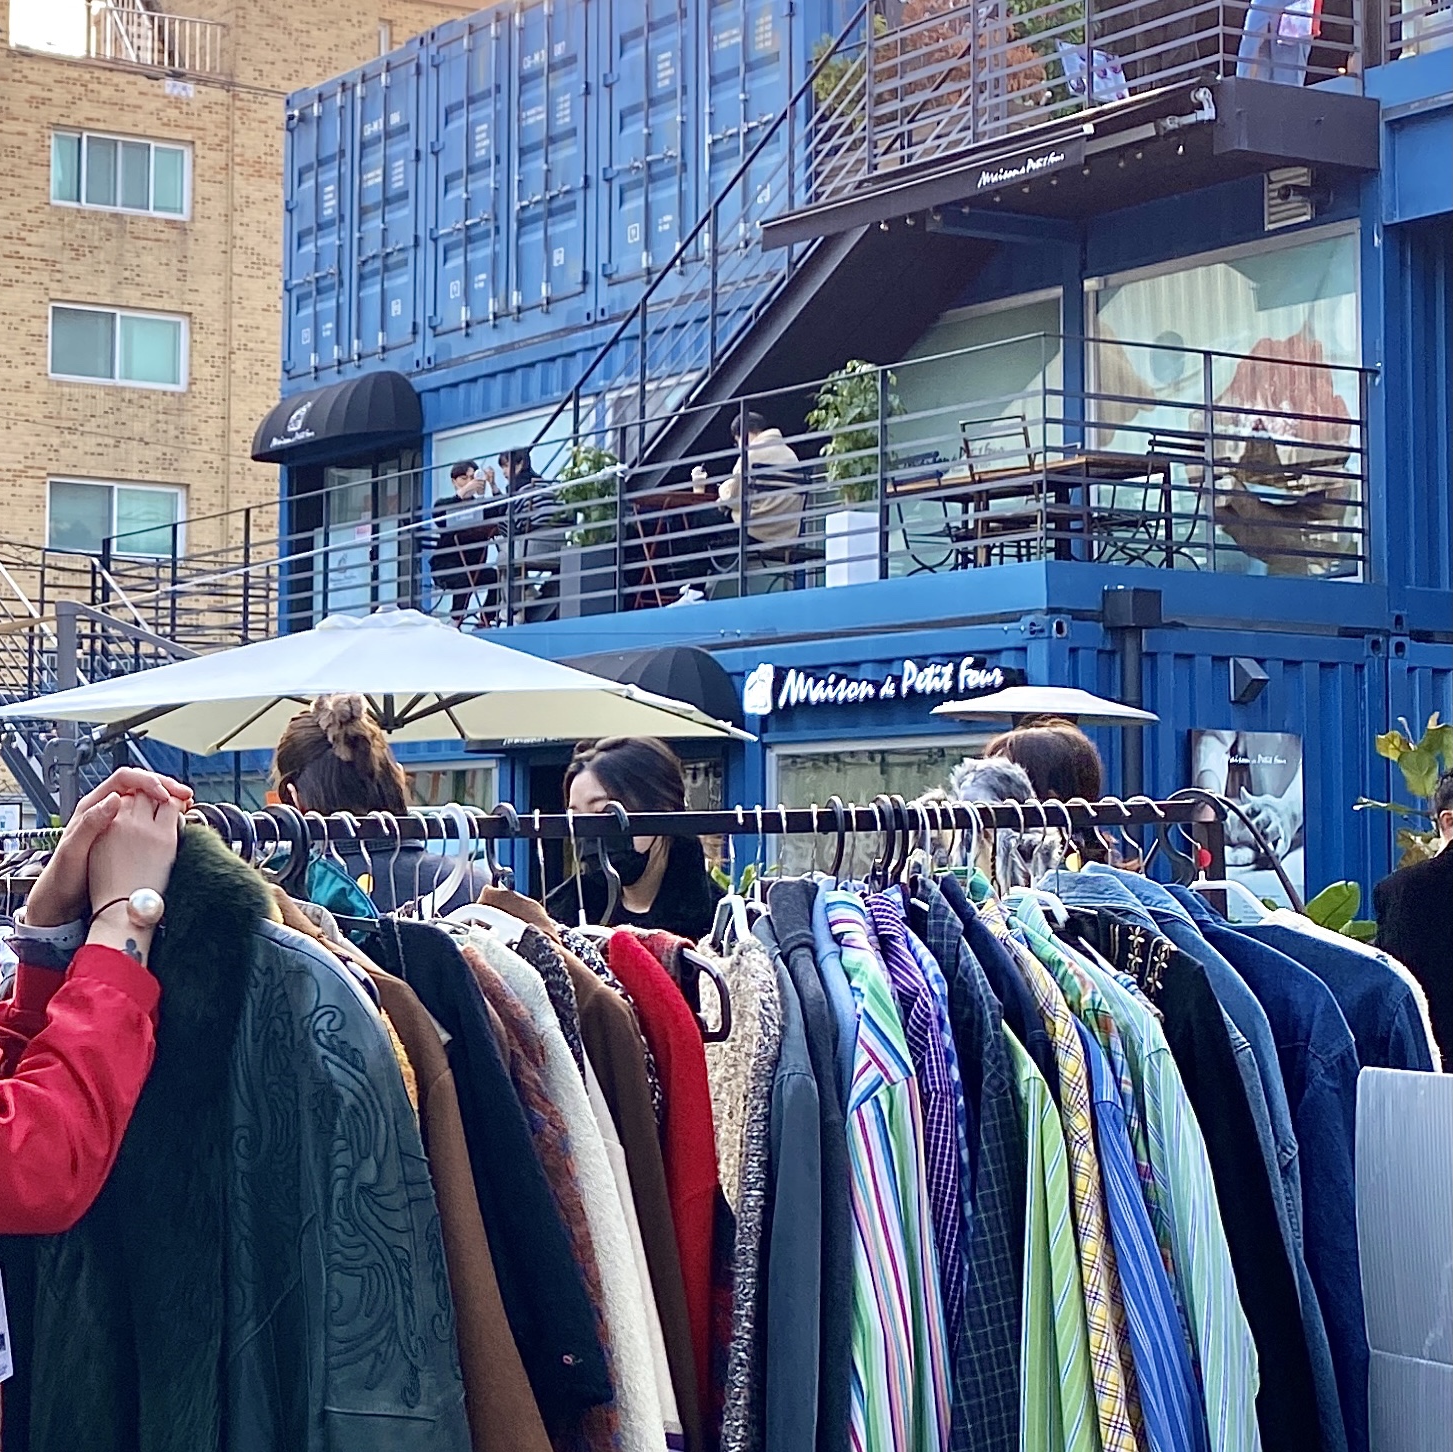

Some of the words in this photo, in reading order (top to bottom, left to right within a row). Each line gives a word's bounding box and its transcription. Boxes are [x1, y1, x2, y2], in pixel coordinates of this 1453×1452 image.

[778, 668, 875, 710] Maison
[901, 658, 954, 698] Petit
[958, 655, 1004, 693] Four
